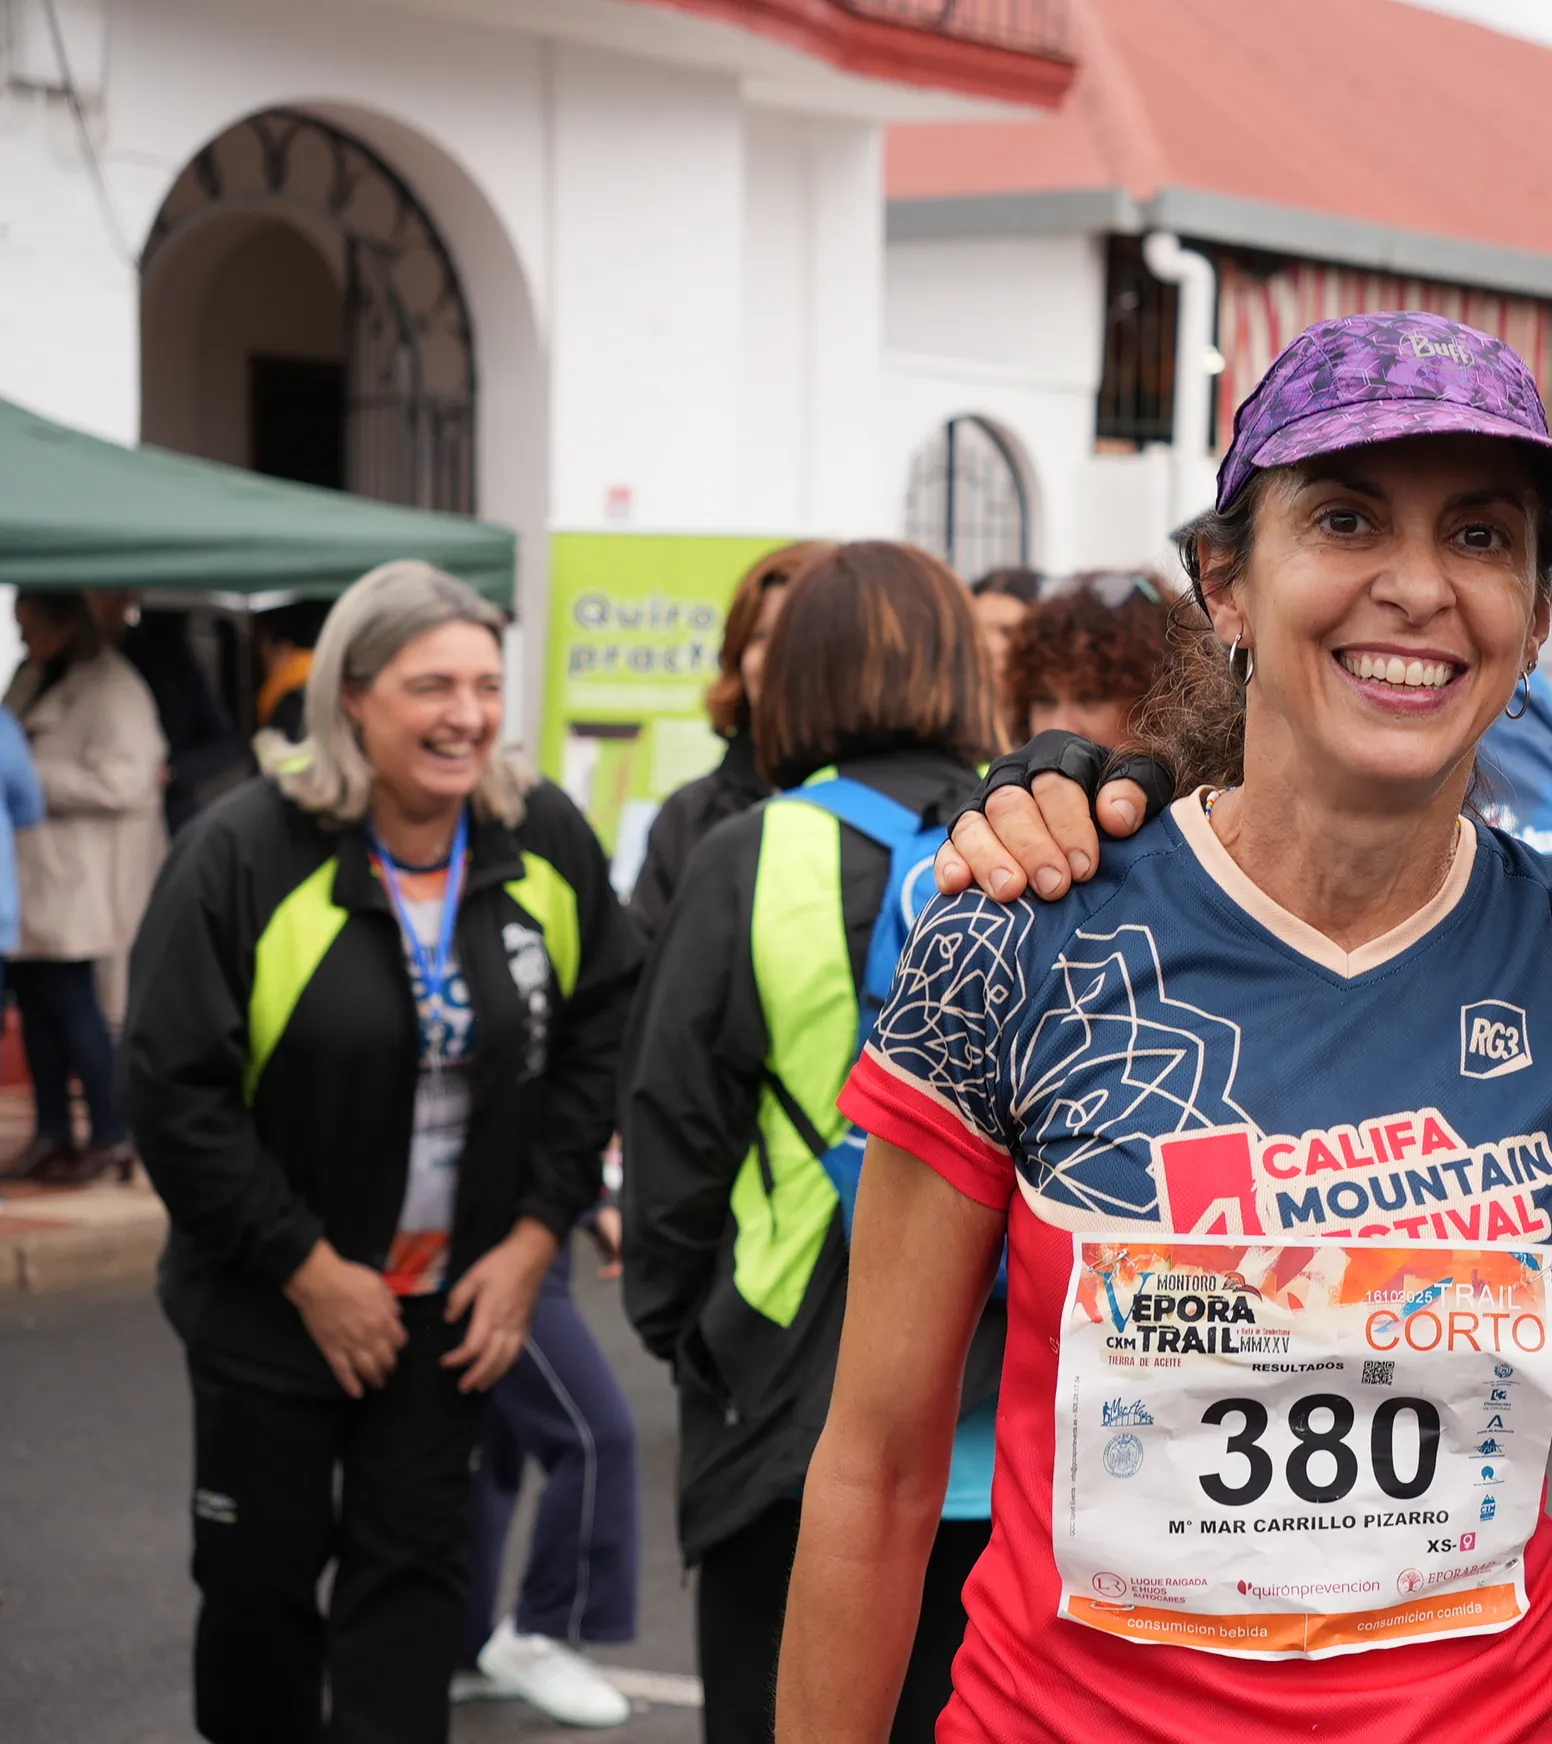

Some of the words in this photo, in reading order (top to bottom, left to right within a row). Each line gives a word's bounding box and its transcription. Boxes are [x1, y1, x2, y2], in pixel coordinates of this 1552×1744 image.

[1407, 334, 1469, 365] Buff
[1468, 1017, 1520, 1060] RG3
[1262, 1116, 1458, 1180] CALIFA
[1310, 1194, 1545, 1241] TIVAL
[1157, 1272, 1217, 1292] MONTORO
[1434, 1282, 1522, 1310] TRAIL
[1132, 1294, 1256, 1324] EPORA
[1106, 1336, 1136, 1350] CXM
[1136, 1325, 1239, 1354] TRAIL
[1240, 1336, 1290, 1354] MMXXV
[1365, 1310, 1546, 1353] CORTO
[1108, 1355, 1135, 1367] TIERRA
[1139, 1356, 1150, 1367] DE
[1153, 1356, 1182, 1368] ACEITE
[1251, 1362, 1345, 1374] RESULTADOS
[1198, 1393, 1441, 1506] 380
[1200, 1520, 1246, 1534] MAR
[1253, 1515, 1357, 1533] CARRILLO
[1364, 1510, 1450, 1528] PIZARRO
[1131, 1577, 1164, 1587] LUQUE
[1165, 1577, 1208, 1587] RAIGADA
[1137, 1586, 1167, 1595] HIJOS
[1132, 1593, 1186, 1604] AUTOCARES
[1127, 1617, 1216, 1636] consumicion
[1219, 1625, 1268, 1638] bebida
[1357, 1611, 1434, 1632] consumicion
[1437, 1602, 1483, 1619] comida
